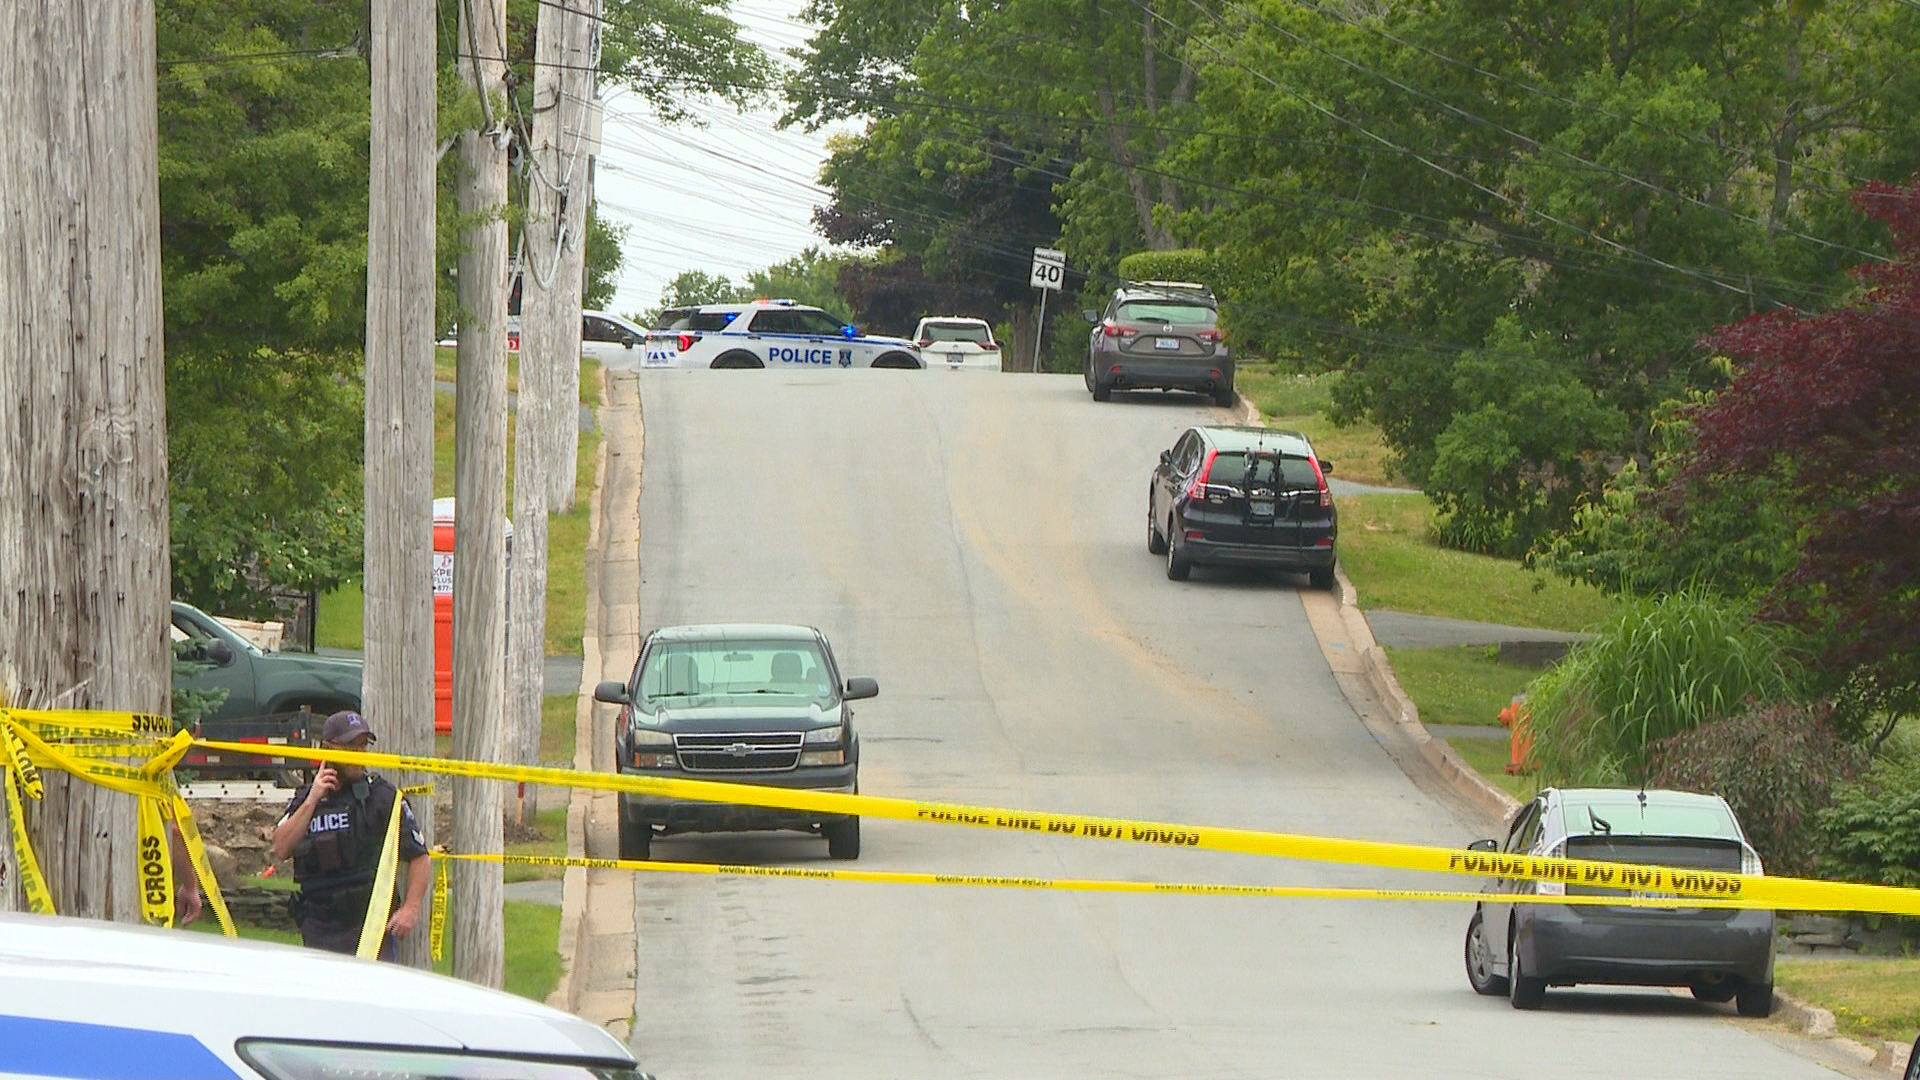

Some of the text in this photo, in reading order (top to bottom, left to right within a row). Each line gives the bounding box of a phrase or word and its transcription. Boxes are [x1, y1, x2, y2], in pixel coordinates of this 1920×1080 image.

[1035, 264, 1060, 282] 40
[769, 347, 832, 365] POLICE
[311, 812, 349, 832] OLICE
[918, 809, 1200, 845] POLICE LINE DO NOT CROSS
[143, 835, 168, 906] CROSS
[1449, 855, 1525, 875] POLICE
[1531, 861, 1578, 880] LINE
[1584, 865, 1614, 883] DO
[1622, 867, 1662, 888] NOT
[1671, 872, 1741, 894] CROSS
